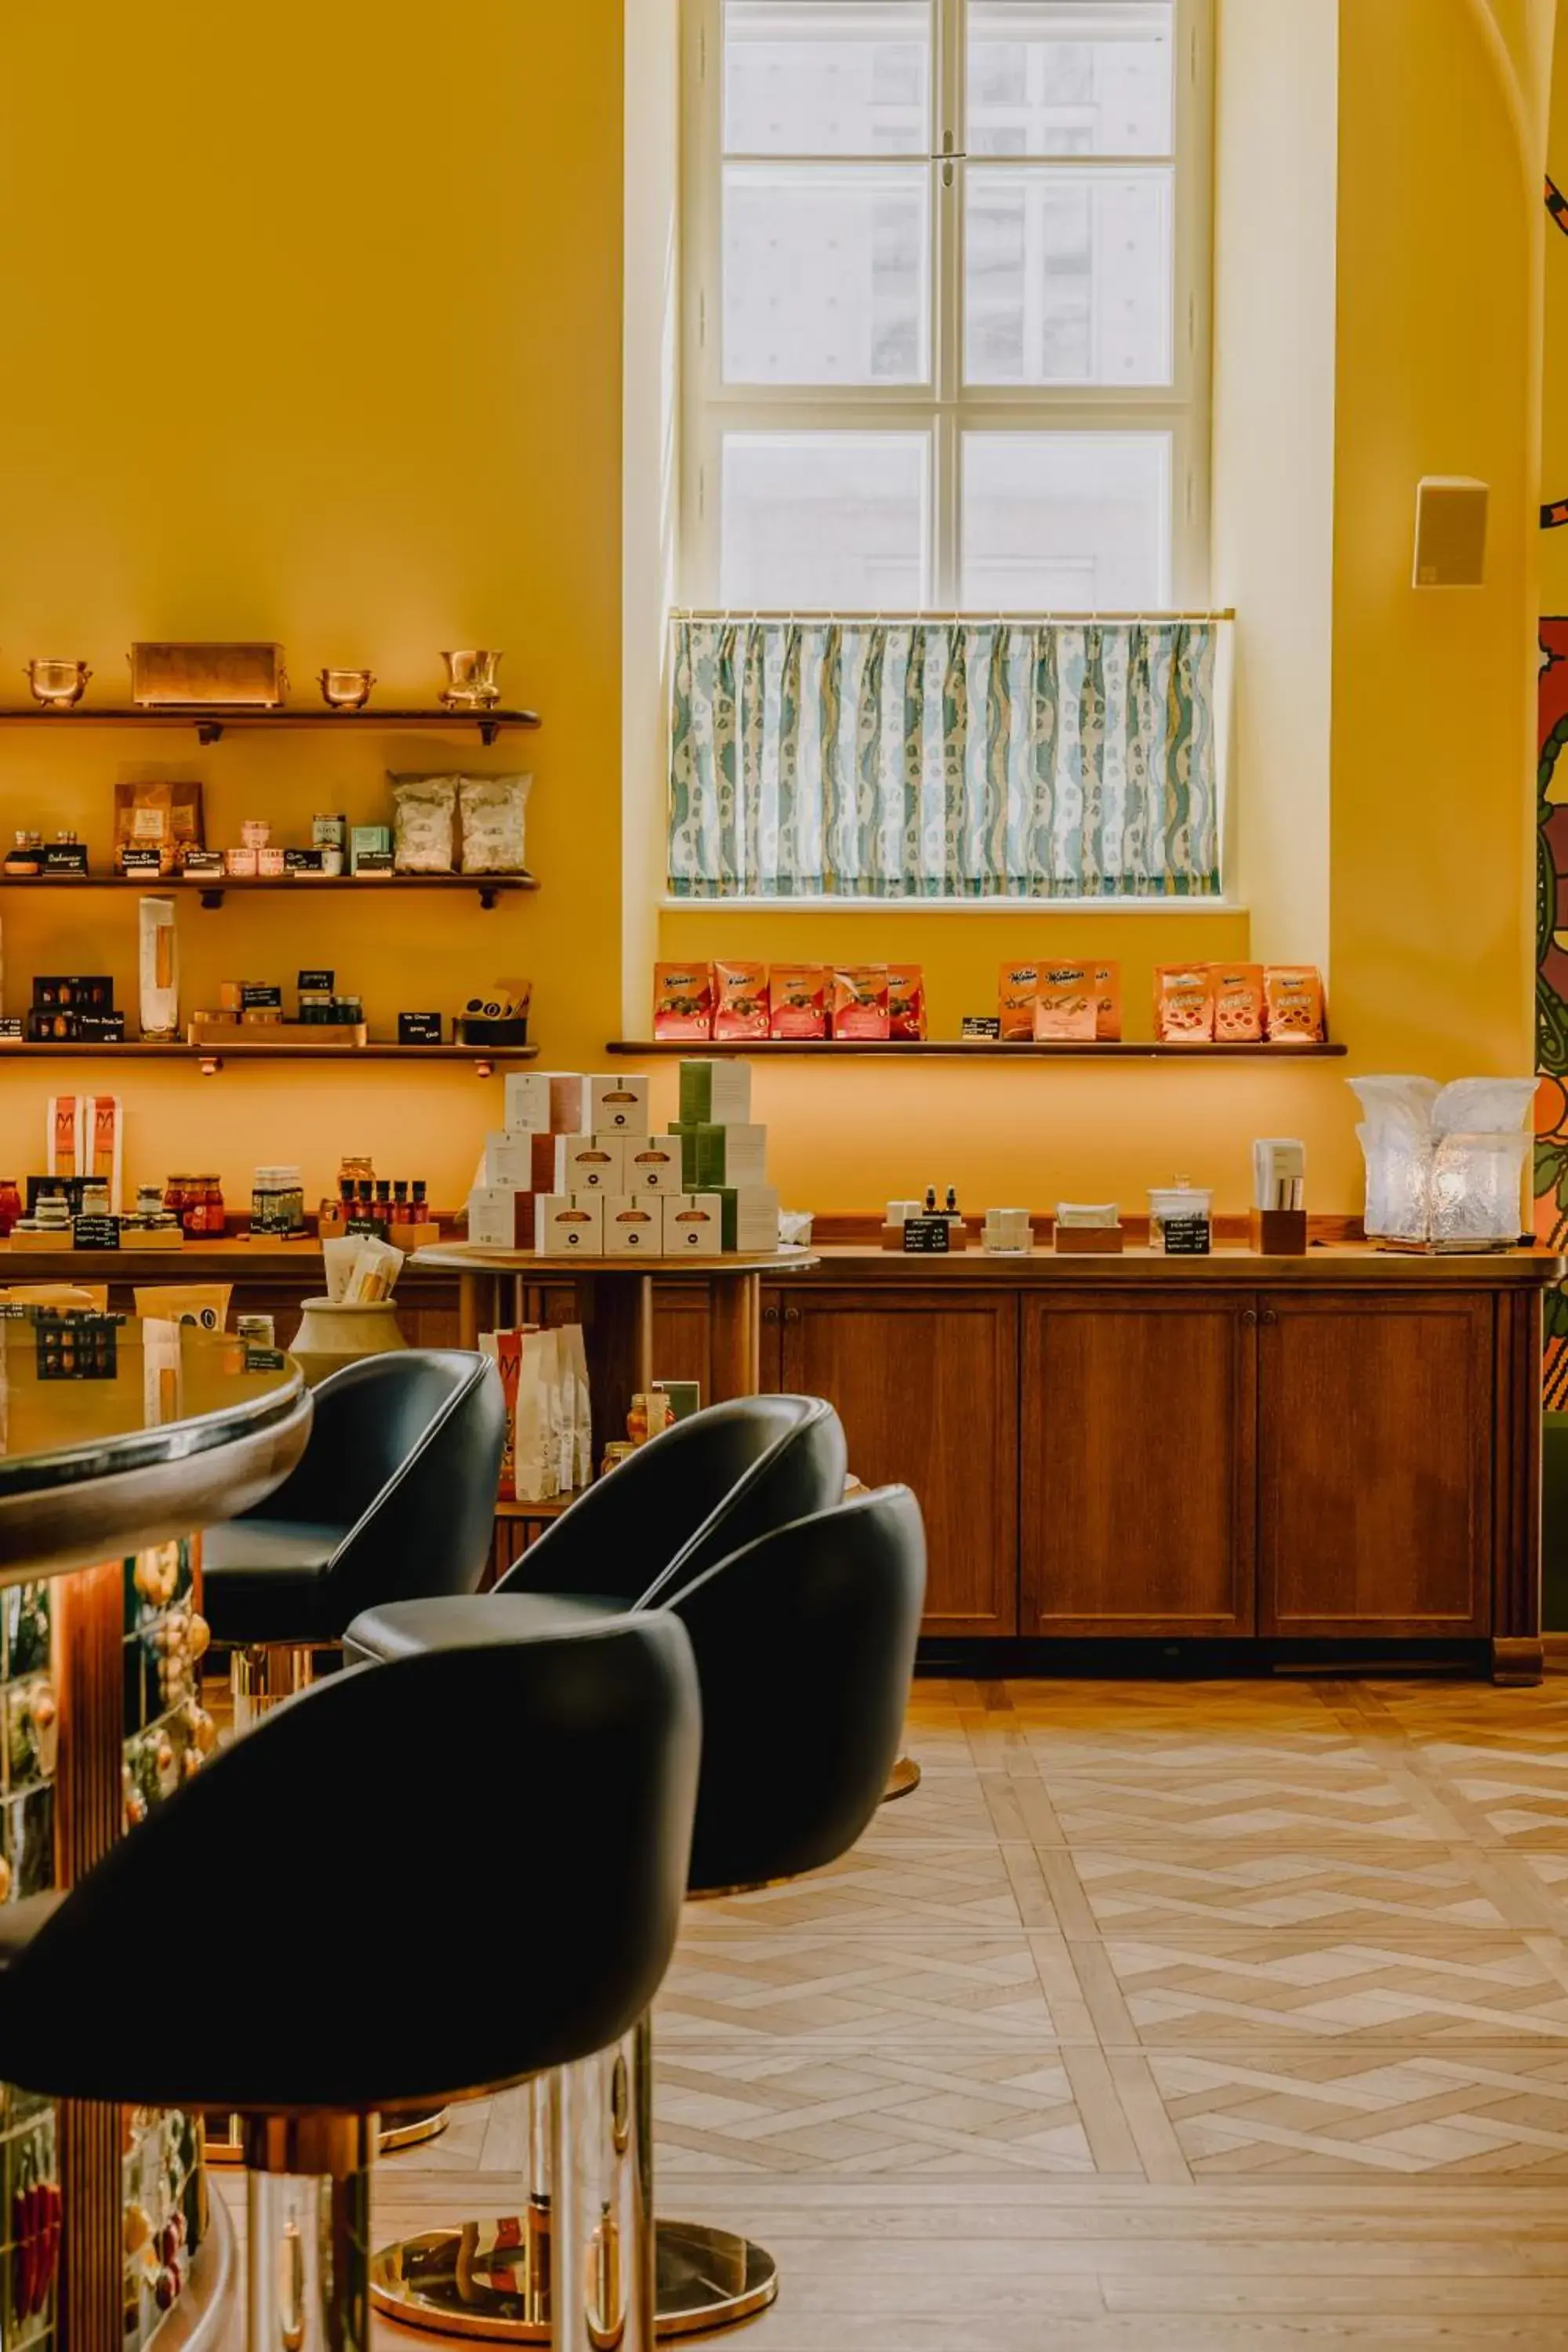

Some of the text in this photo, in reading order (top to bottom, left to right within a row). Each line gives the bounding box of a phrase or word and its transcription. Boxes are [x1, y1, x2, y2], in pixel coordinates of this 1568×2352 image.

[57, 1112, 74, 1130] M
[96, 1111, 114, 1130] M
[499, 1354, 519, 1381] M
